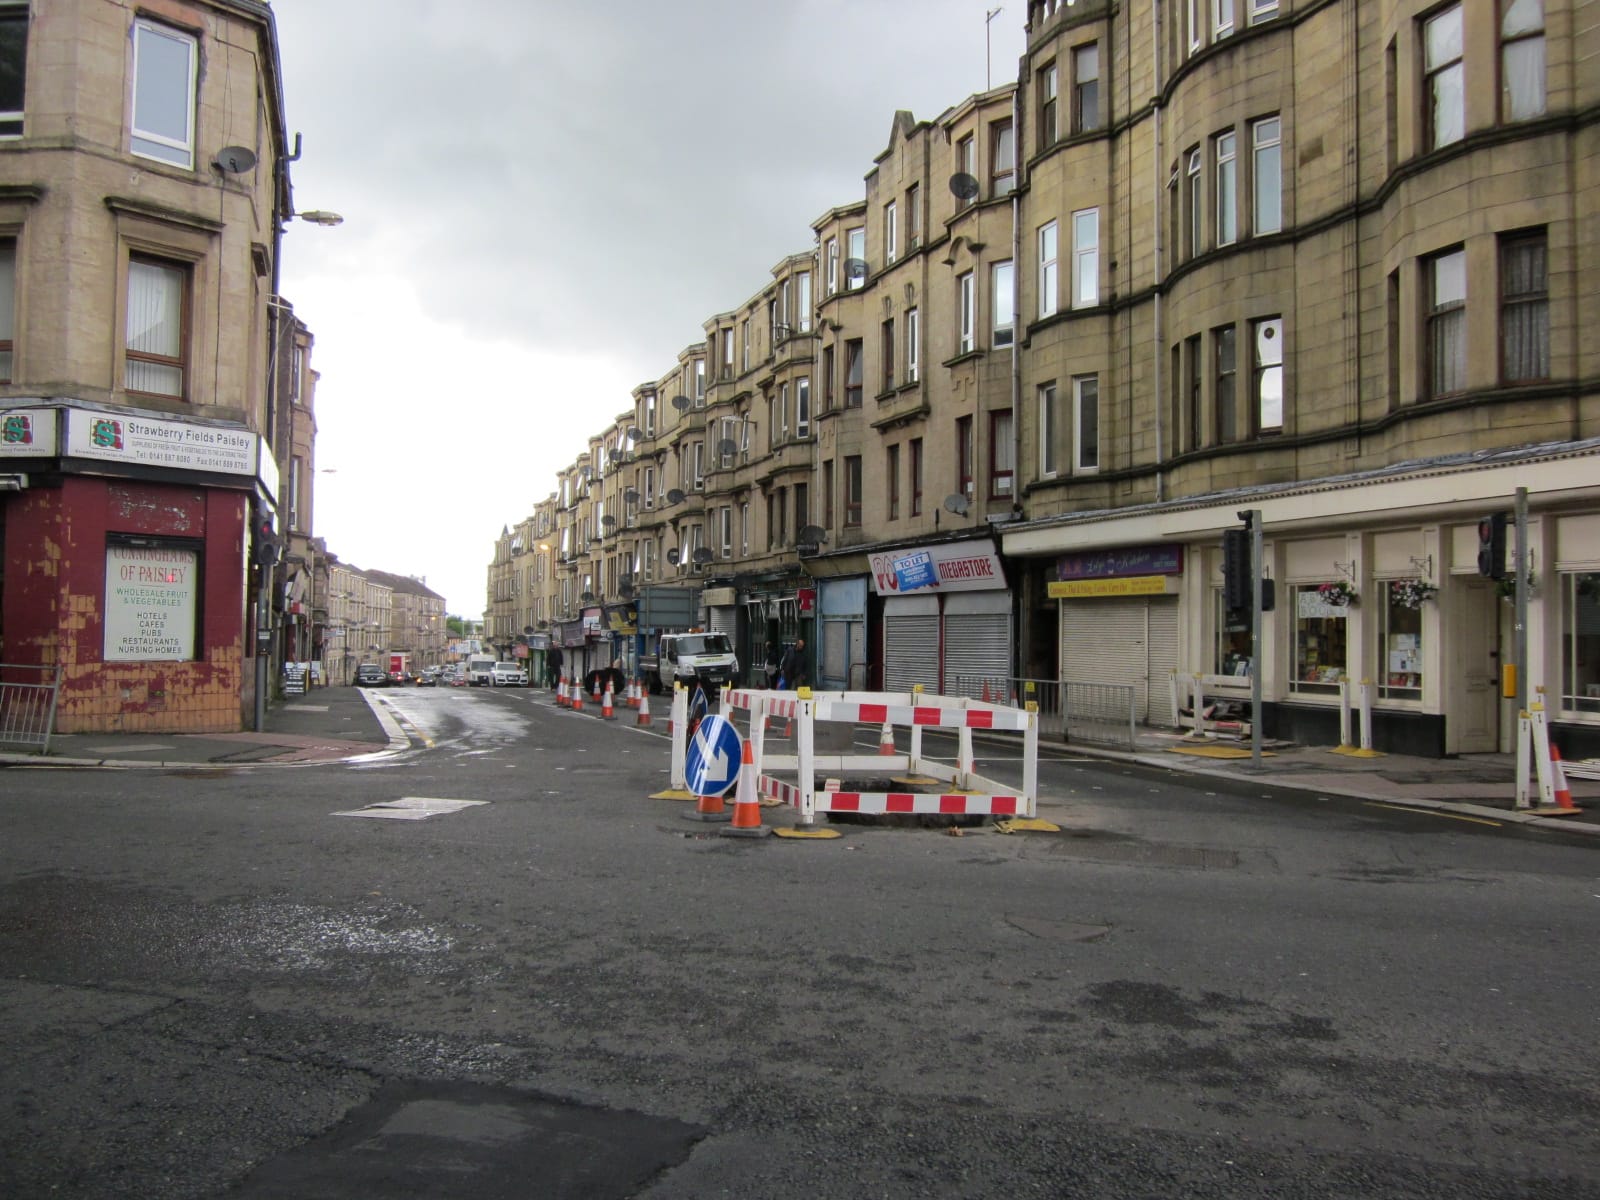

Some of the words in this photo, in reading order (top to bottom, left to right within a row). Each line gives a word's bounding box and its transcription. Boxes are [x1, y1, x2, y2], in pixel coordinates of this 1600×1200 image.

[129, 422, 184, 442] Strawberry
[186, 429, 215, 443] Fields
[216, 433, 250, 449] Paisley
[899, 560, 911, 569] TO
[911, 556, 924, 566] LET
[120, 564, 136, 581] OF
[139, 565, 187, 584] PAISLEY
[938, 558, 994, 580] MEGASTORE
[116, 587, 165, 598] WHOLESALE
[166, 590, 188, 599] FRUIT
[130, 597, 182, 607] VEGETABLES
[137, 611, 168, 620] HOTELS
[139, 620, 165, 629] CAFES
[141, 629, 162, 637] PUBS
[122, 637, 179, 646] RESTAURANTS
[119, 646, 153, 654] NURSING
[155, 646, 182, 654] HOMES
